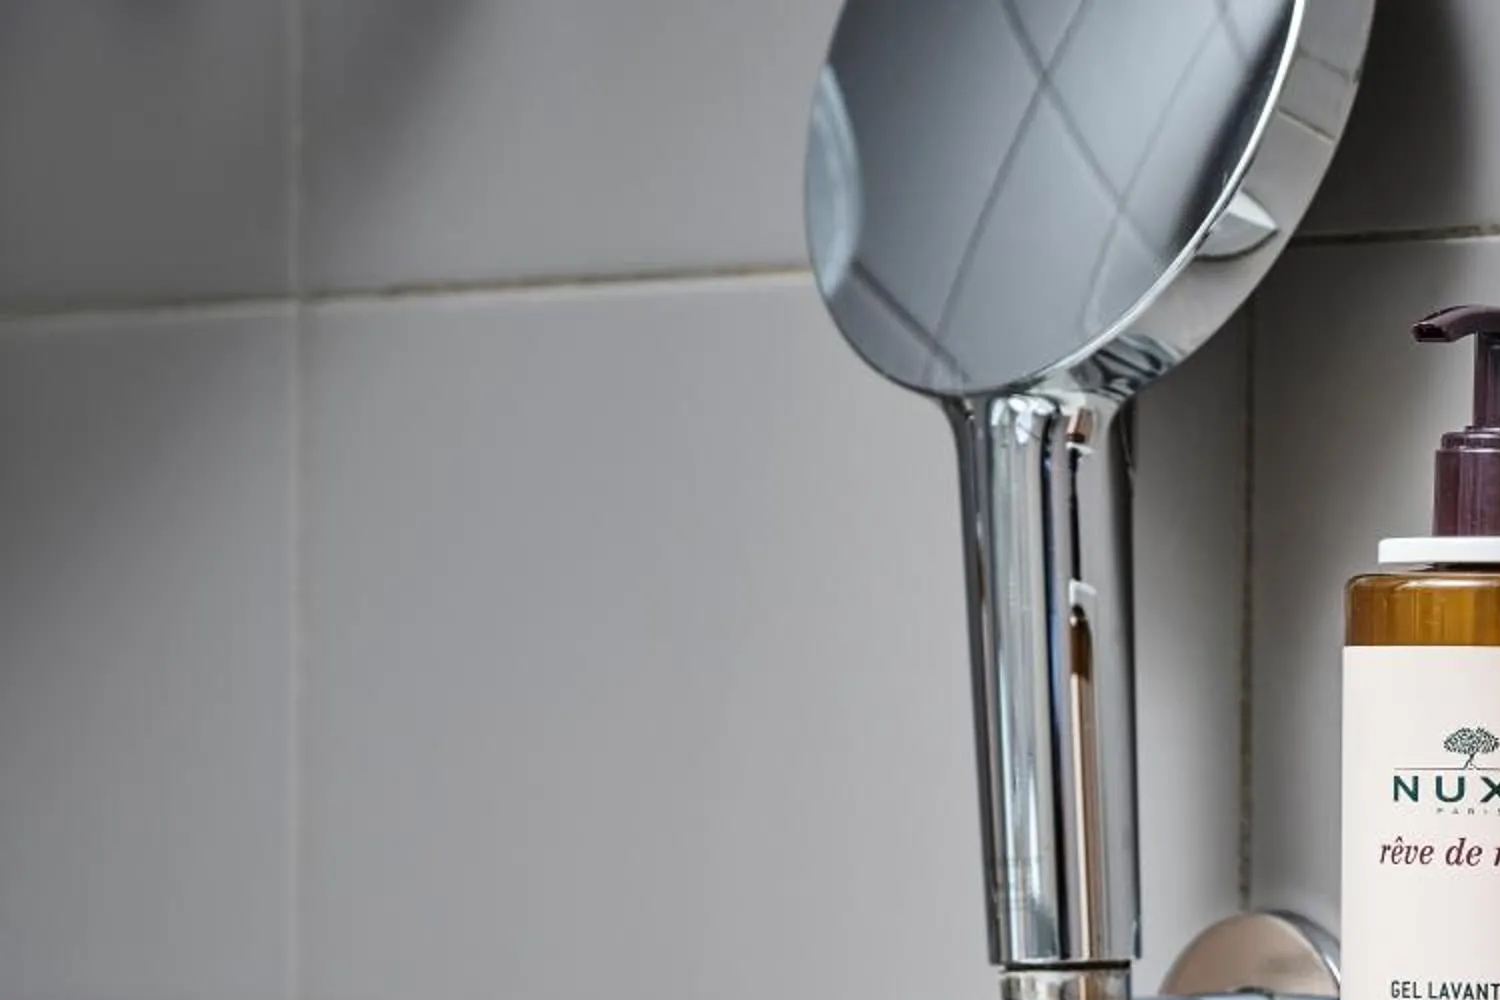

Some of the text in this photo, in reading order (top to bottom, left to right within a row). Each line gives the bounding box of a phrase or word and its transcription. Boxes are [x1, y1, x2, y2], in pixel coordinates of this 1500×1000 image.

[1379, 835, 1435, 865] rêve
[1445, 837, 1483, 867] de
[1390, 979, 1423, 1000] GEL
